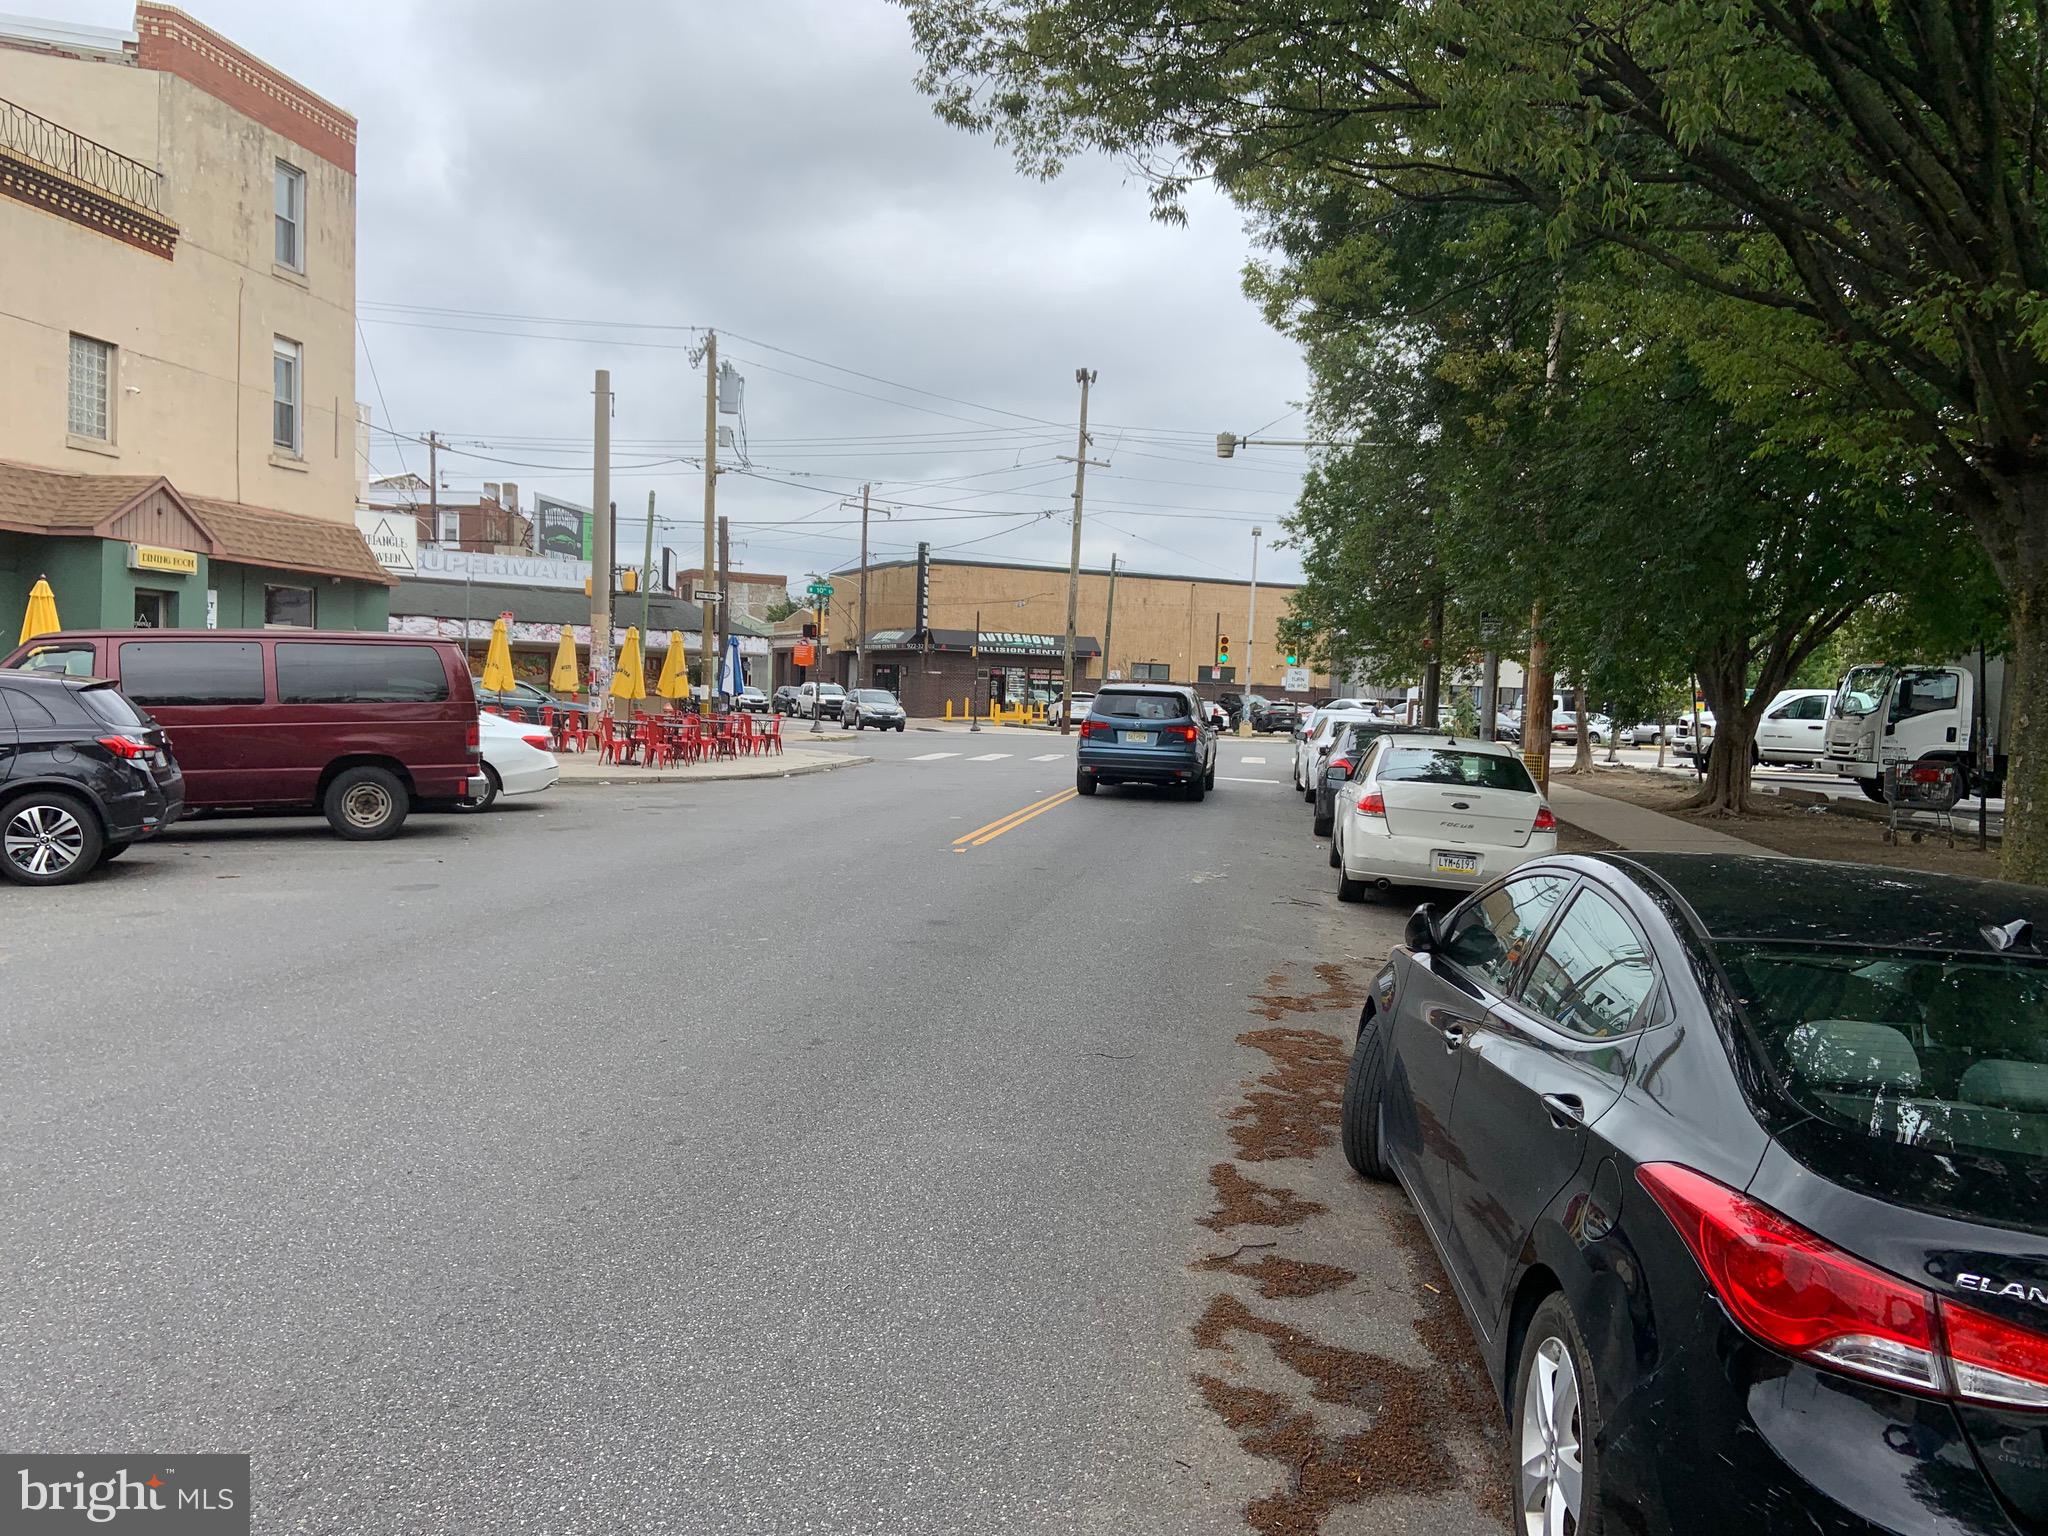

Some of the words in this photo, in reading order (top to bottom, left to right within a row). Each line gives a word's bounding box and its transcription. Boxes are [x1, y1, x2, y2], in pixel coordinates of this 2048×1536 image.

[545, 507, 579, 535] AUTOSHOW
[376, 552, 401, 563] AVERN
[978, 633, 1055, 645] AUTOSHOW
[970, 645, 1026, 654] OLLISION
[1440, 821, 1475, 829] FOCUS
